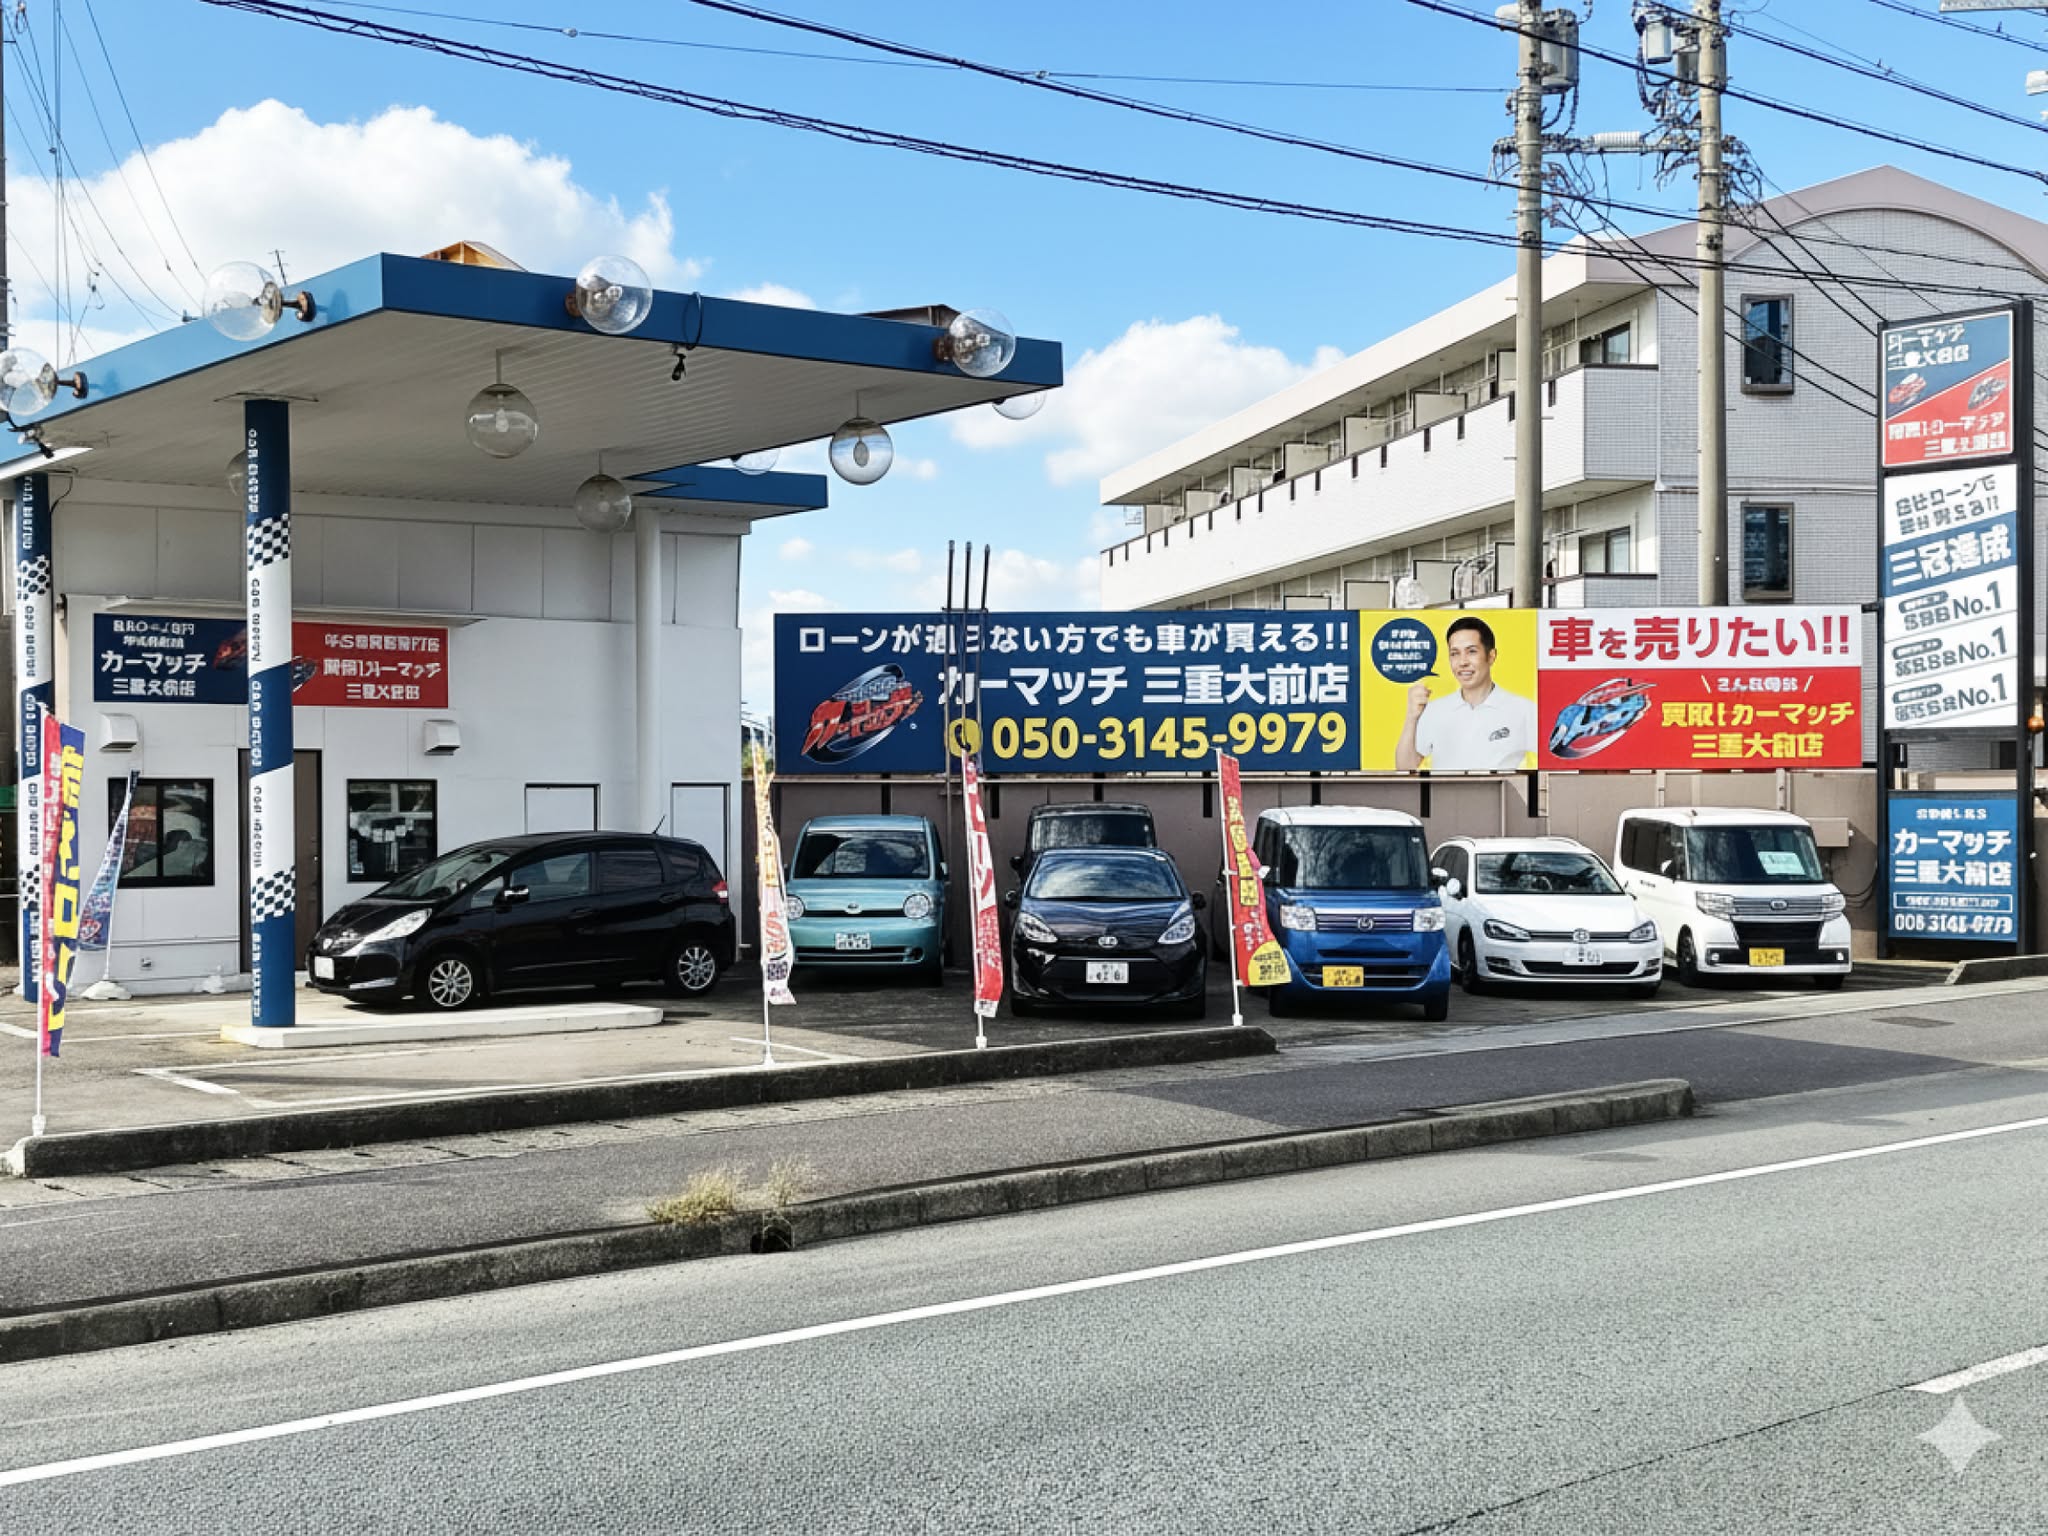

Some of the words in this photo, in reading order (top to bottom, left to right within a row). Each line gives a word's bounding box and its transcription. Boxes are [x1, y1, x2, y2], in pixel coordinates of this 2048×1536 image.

[1548, 616, 1849, 662] 車を売りたい!!
[100, 650, 207, 675] カーマッチ
[938, 665, 1128, 706] カーマッチ
[1143, 663, 1350, 705] 三重大前店
[991, 711, 1347, 759] 050-3145-9979
[1893, 828, 2012, 855] カーマッチ
